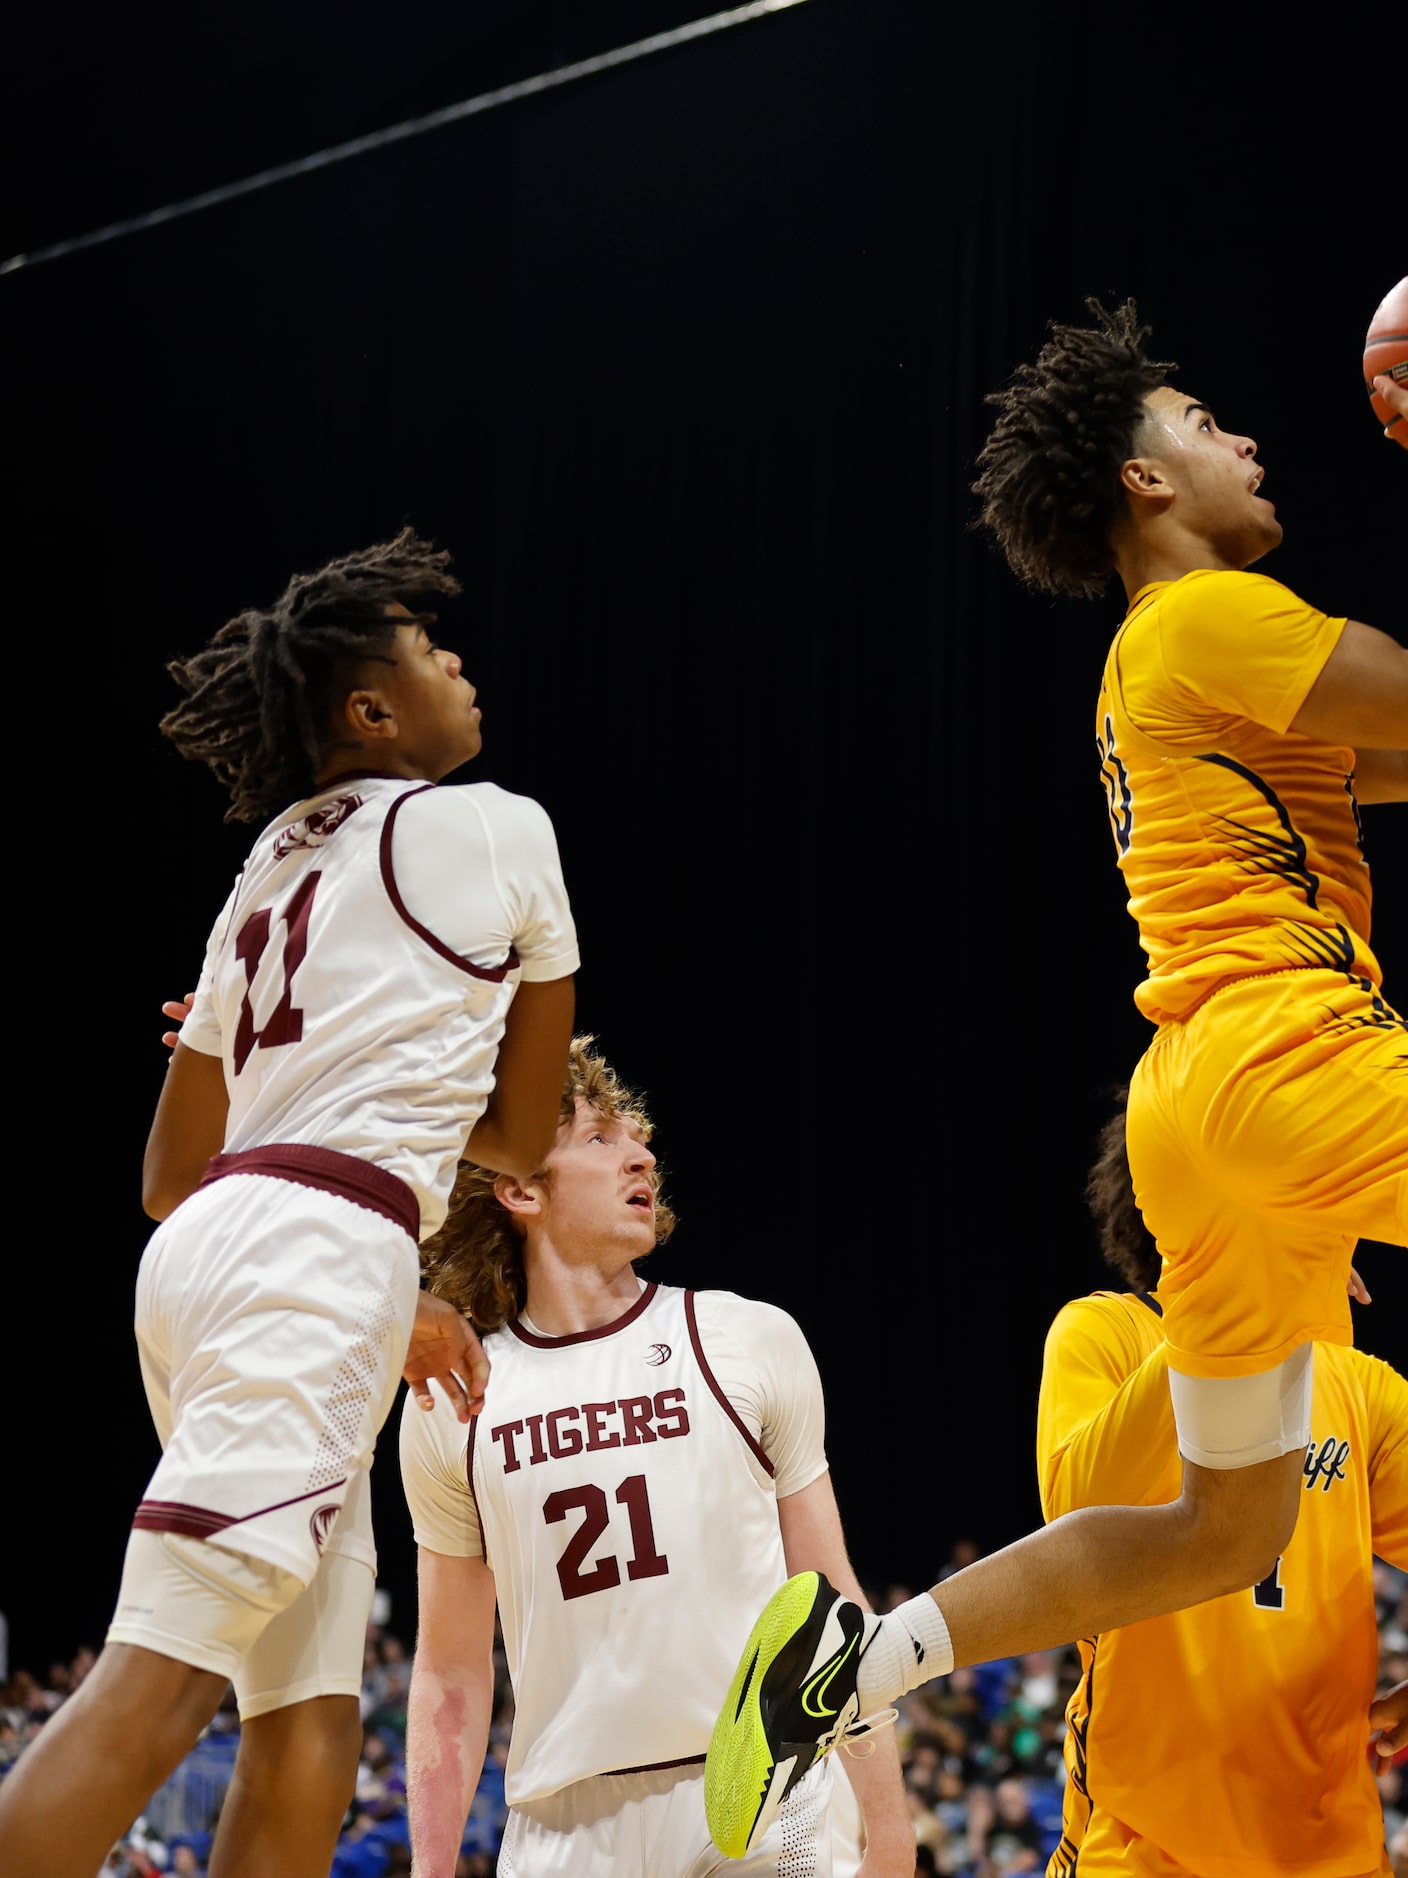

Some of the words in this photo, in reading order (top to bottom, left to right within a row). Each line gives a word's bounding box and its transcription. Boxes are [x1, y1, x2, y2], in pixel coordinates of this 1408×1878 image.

[233, 869, 322, 1077] 11
[491, 1387, 690, 1474] TIGERS
[1302, 1434, 1350, 1492] iff
[542, 1473, 669, 1601] 21
